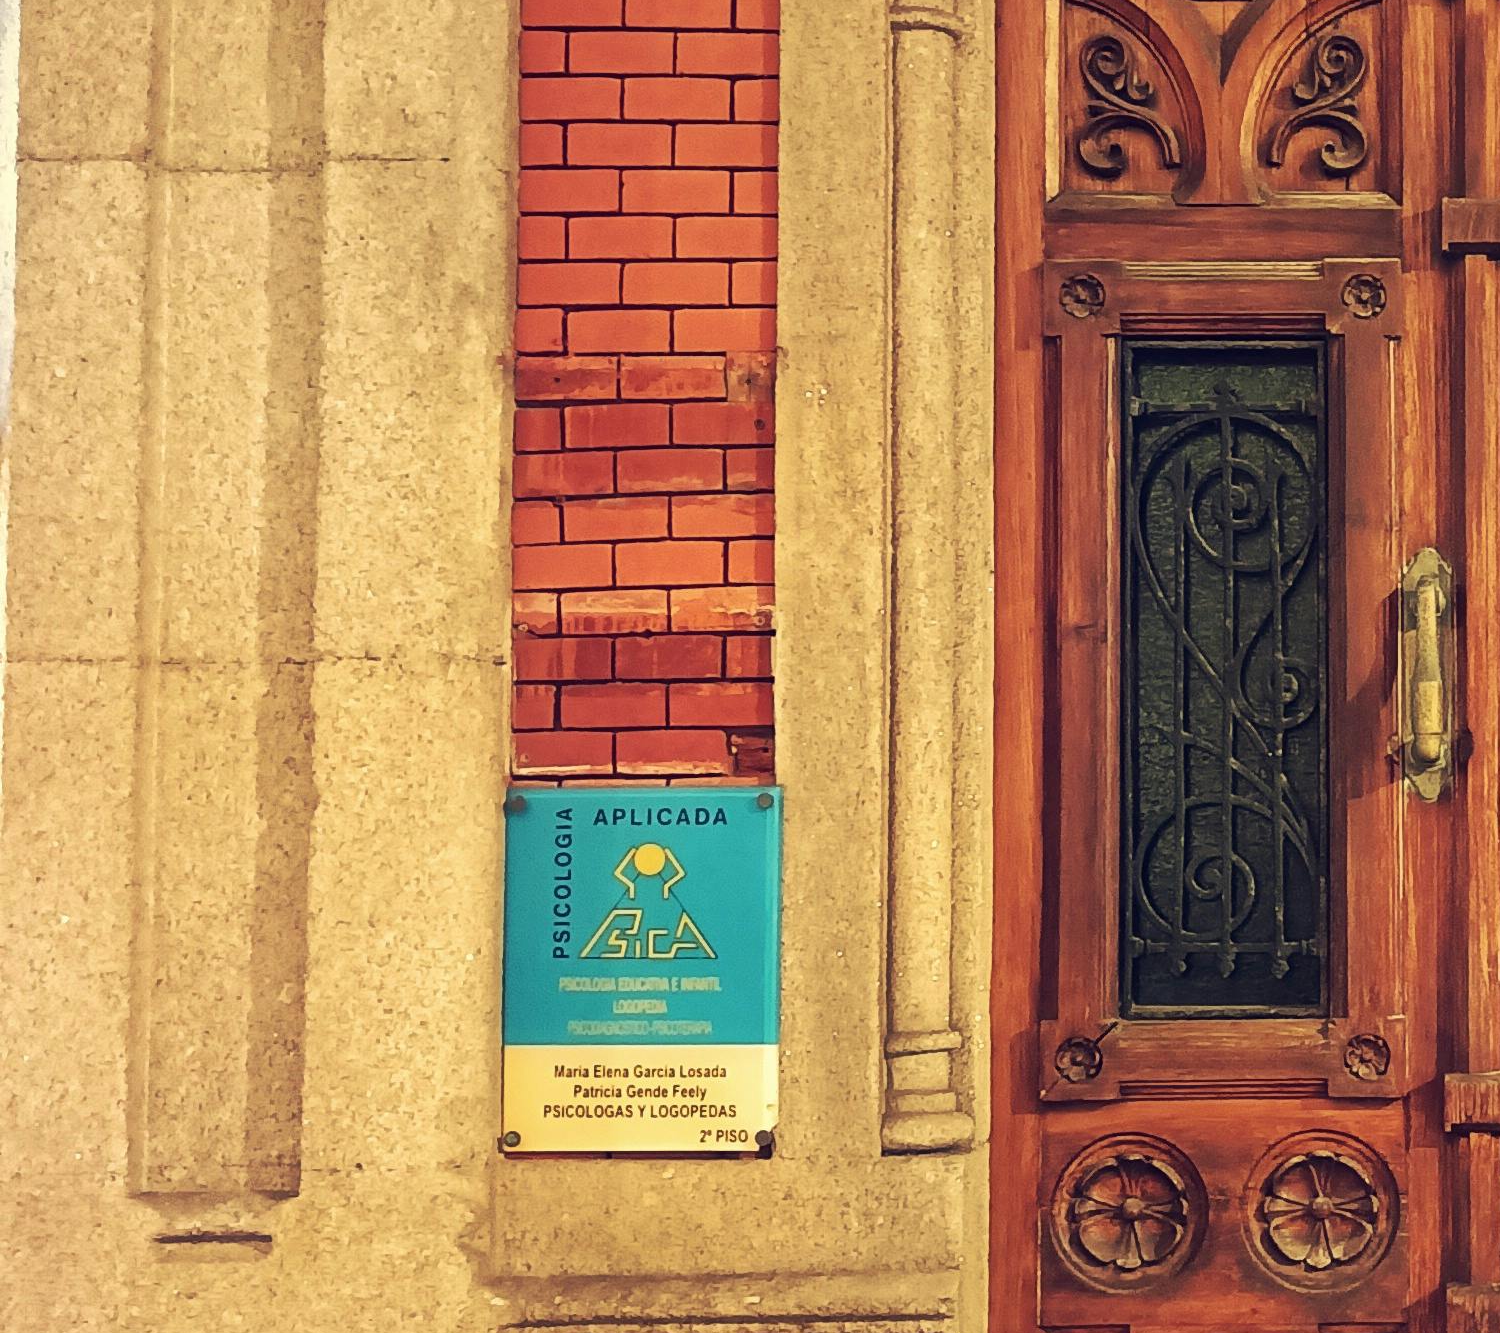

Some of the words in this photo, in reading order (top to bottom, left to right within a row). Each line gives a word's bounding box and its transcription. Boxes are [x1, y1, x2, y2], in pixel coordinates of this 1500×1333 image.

[593, 807, 728, 826] APLICADA
[552, 807, 573, 959] PSICOLOGIA
[593, 1064, 629, 1078] Elena
[679, 1064, 727, 1078] Losada
[573, 1084, 622, 1098] Patricia
[626, 1084, 668, 1098] Gende
[672, 1084, 707, 1101] Feely
[543, 1104, 633, 1118] PSICOLOGAS
[638, 1104, 646, 1118] Y
[650, 1104, 737, 1118] LOGOPEDAS
[716, 1129, 749, 1143] PISO
